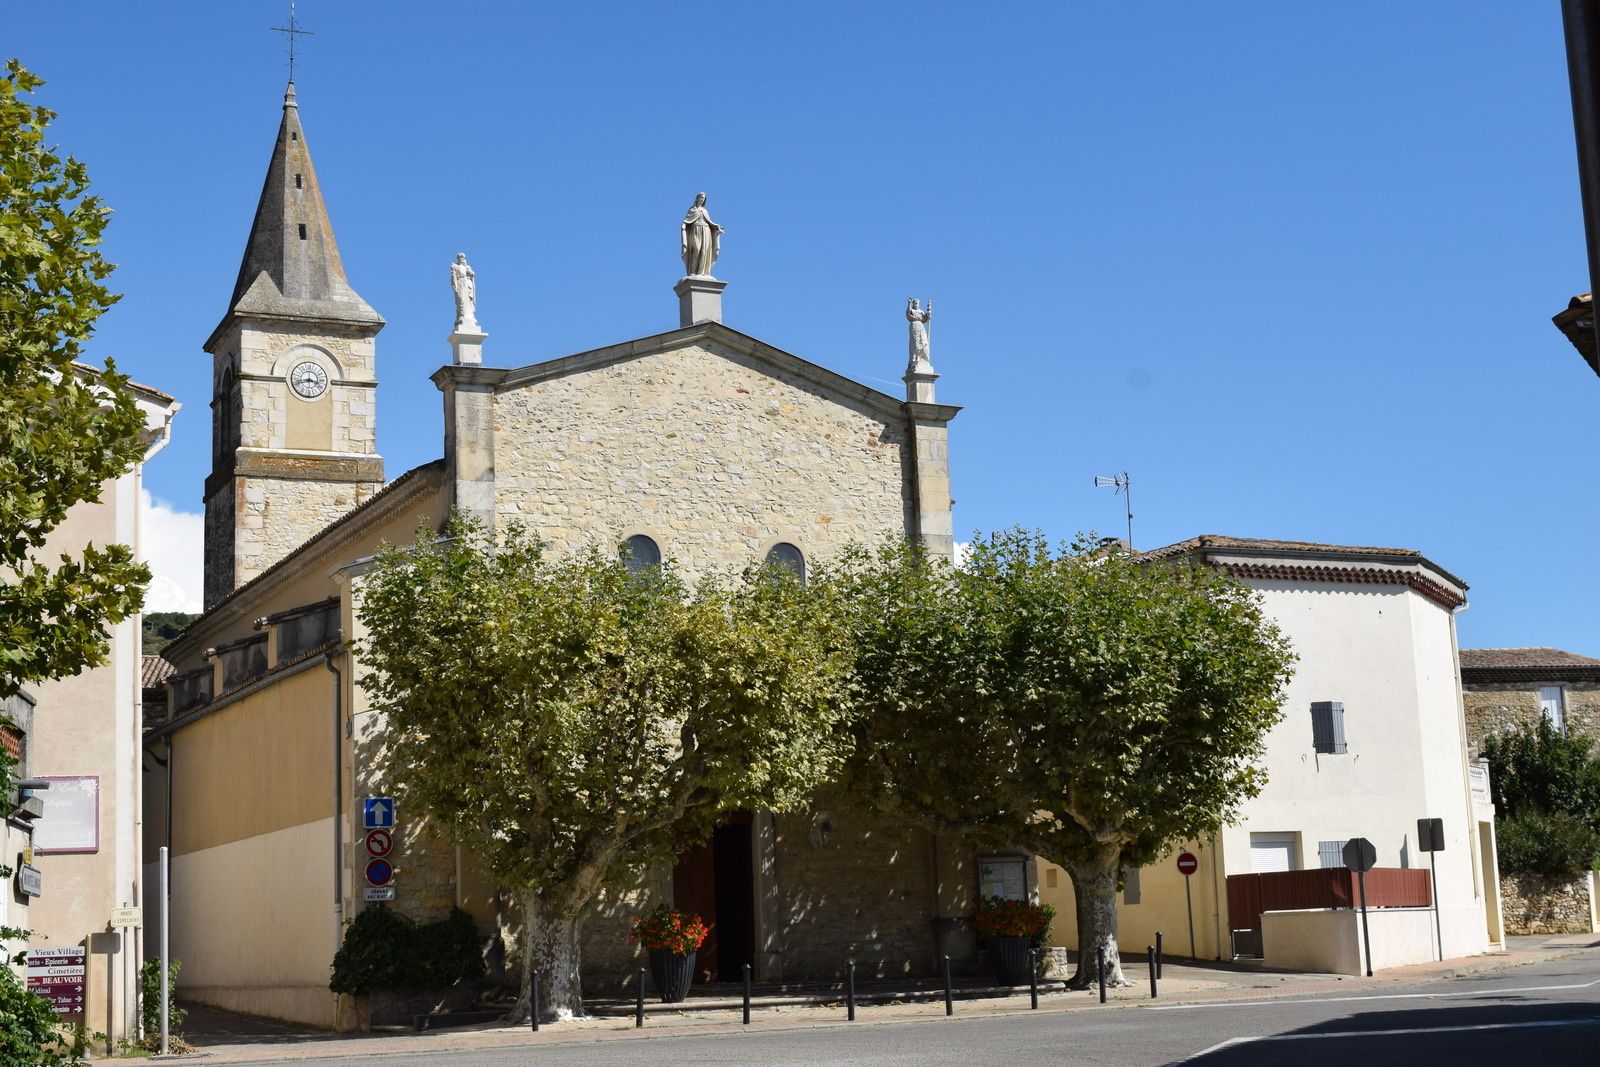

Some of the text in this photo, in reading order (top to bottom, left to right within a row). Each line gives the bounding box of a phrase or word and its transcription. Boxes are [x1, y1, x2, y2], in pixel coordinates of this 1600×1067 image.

[58, 948, 83, 956] Village
[44, 957, 69, 967] Epicerie
[47, 967, 83, 975] Cimetière
[42, 976, 83, 984] BEAUVOIR
